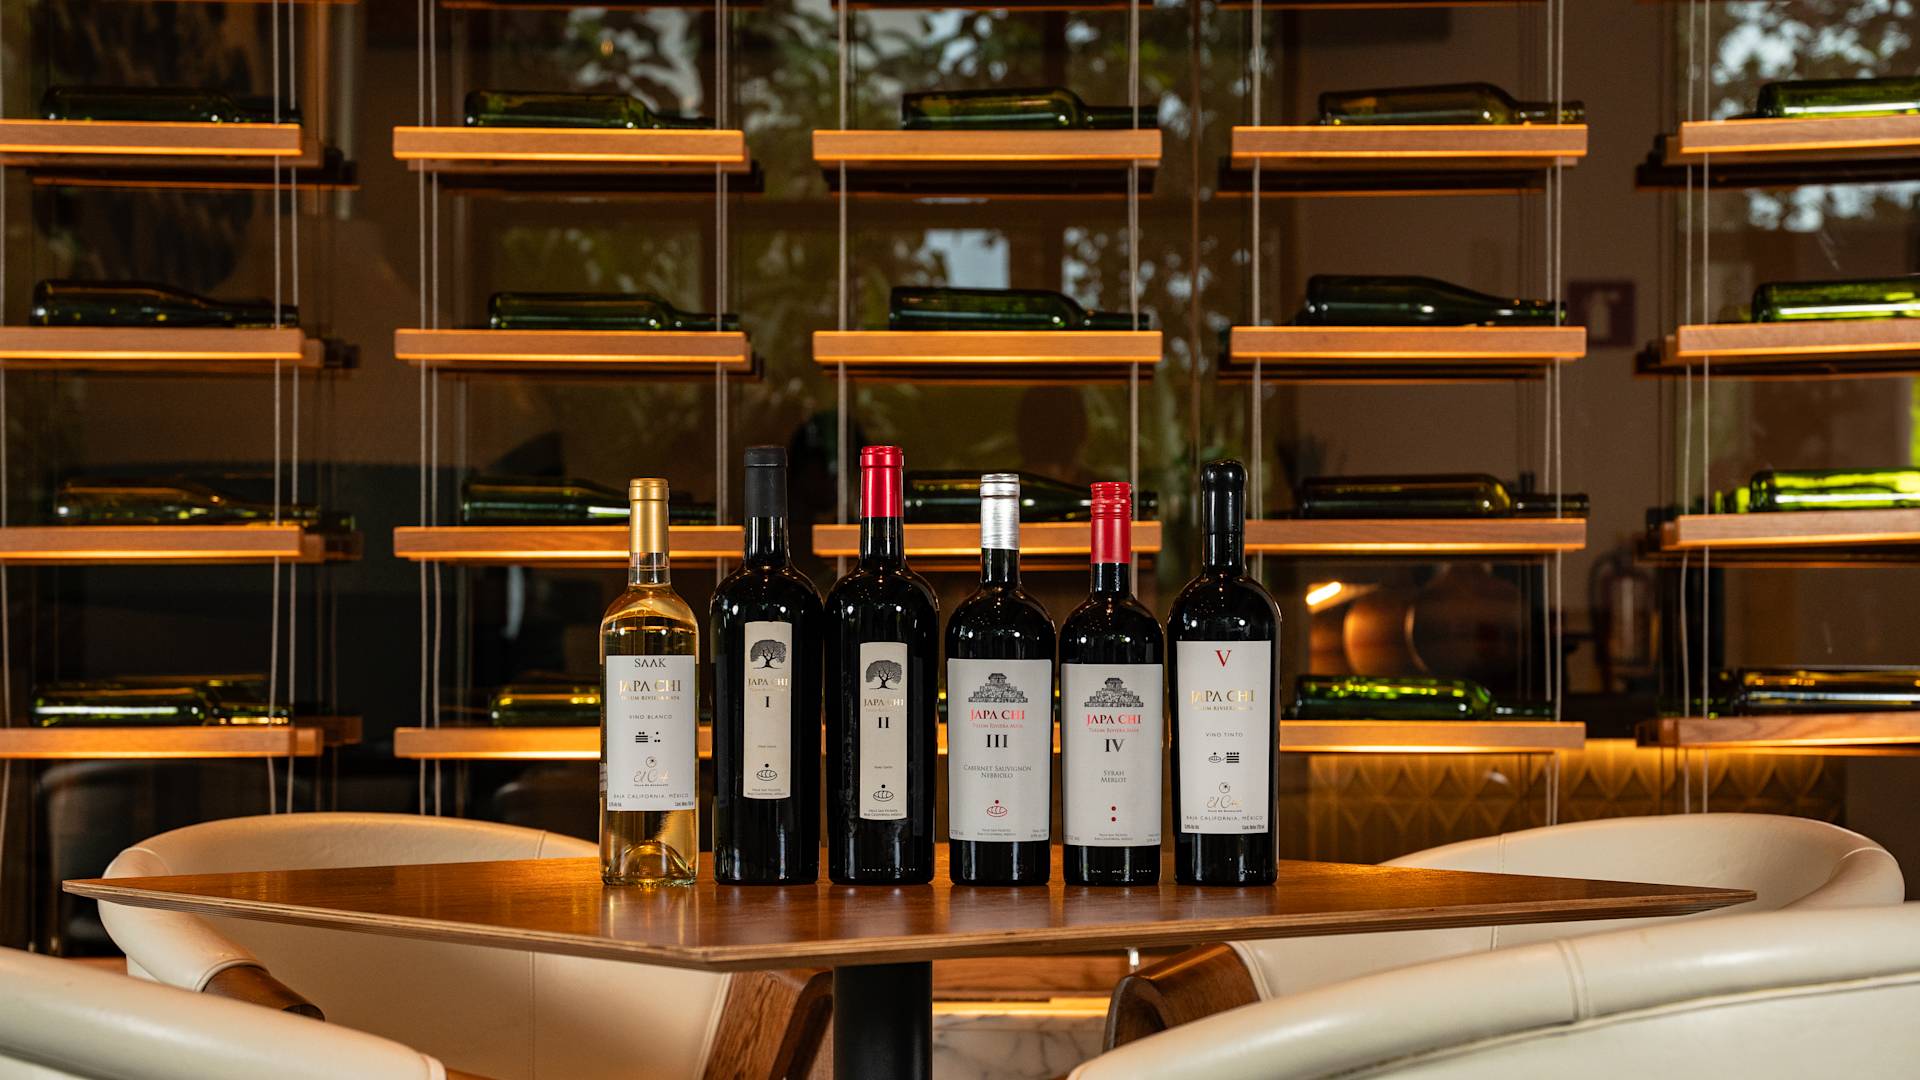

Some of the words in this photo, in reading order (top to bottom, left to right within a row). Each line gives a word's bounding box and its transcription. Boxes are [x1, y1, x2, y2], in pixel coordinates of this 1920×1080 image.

[634, 658, 667, 668] SAAK
[1215, 650, 1232, 667] V
[619, 679, 651, 695] JAPA
[655, 679, 681, 692] CHI
[748, 678, 768, 686] JAPA
[770, 678, 788, 686] HI
[764, 696, 770, 708] I
[864, 698, 885, 706] JAPA
[1190, 690, 1222, 704] JAPA
[1226, 690, 1254, 702] CHI
[970, 709, 998, 721] JAPA
[1002, 710, 1025, 720] CHI
[1087, 714, 1114, 726] JAPA
[1118, 714, 1142, 724] CHI
[878, 716, 890, 728] II
[986, 734, 1008, 748] III
[1105, 738, 1125, 752] IV
